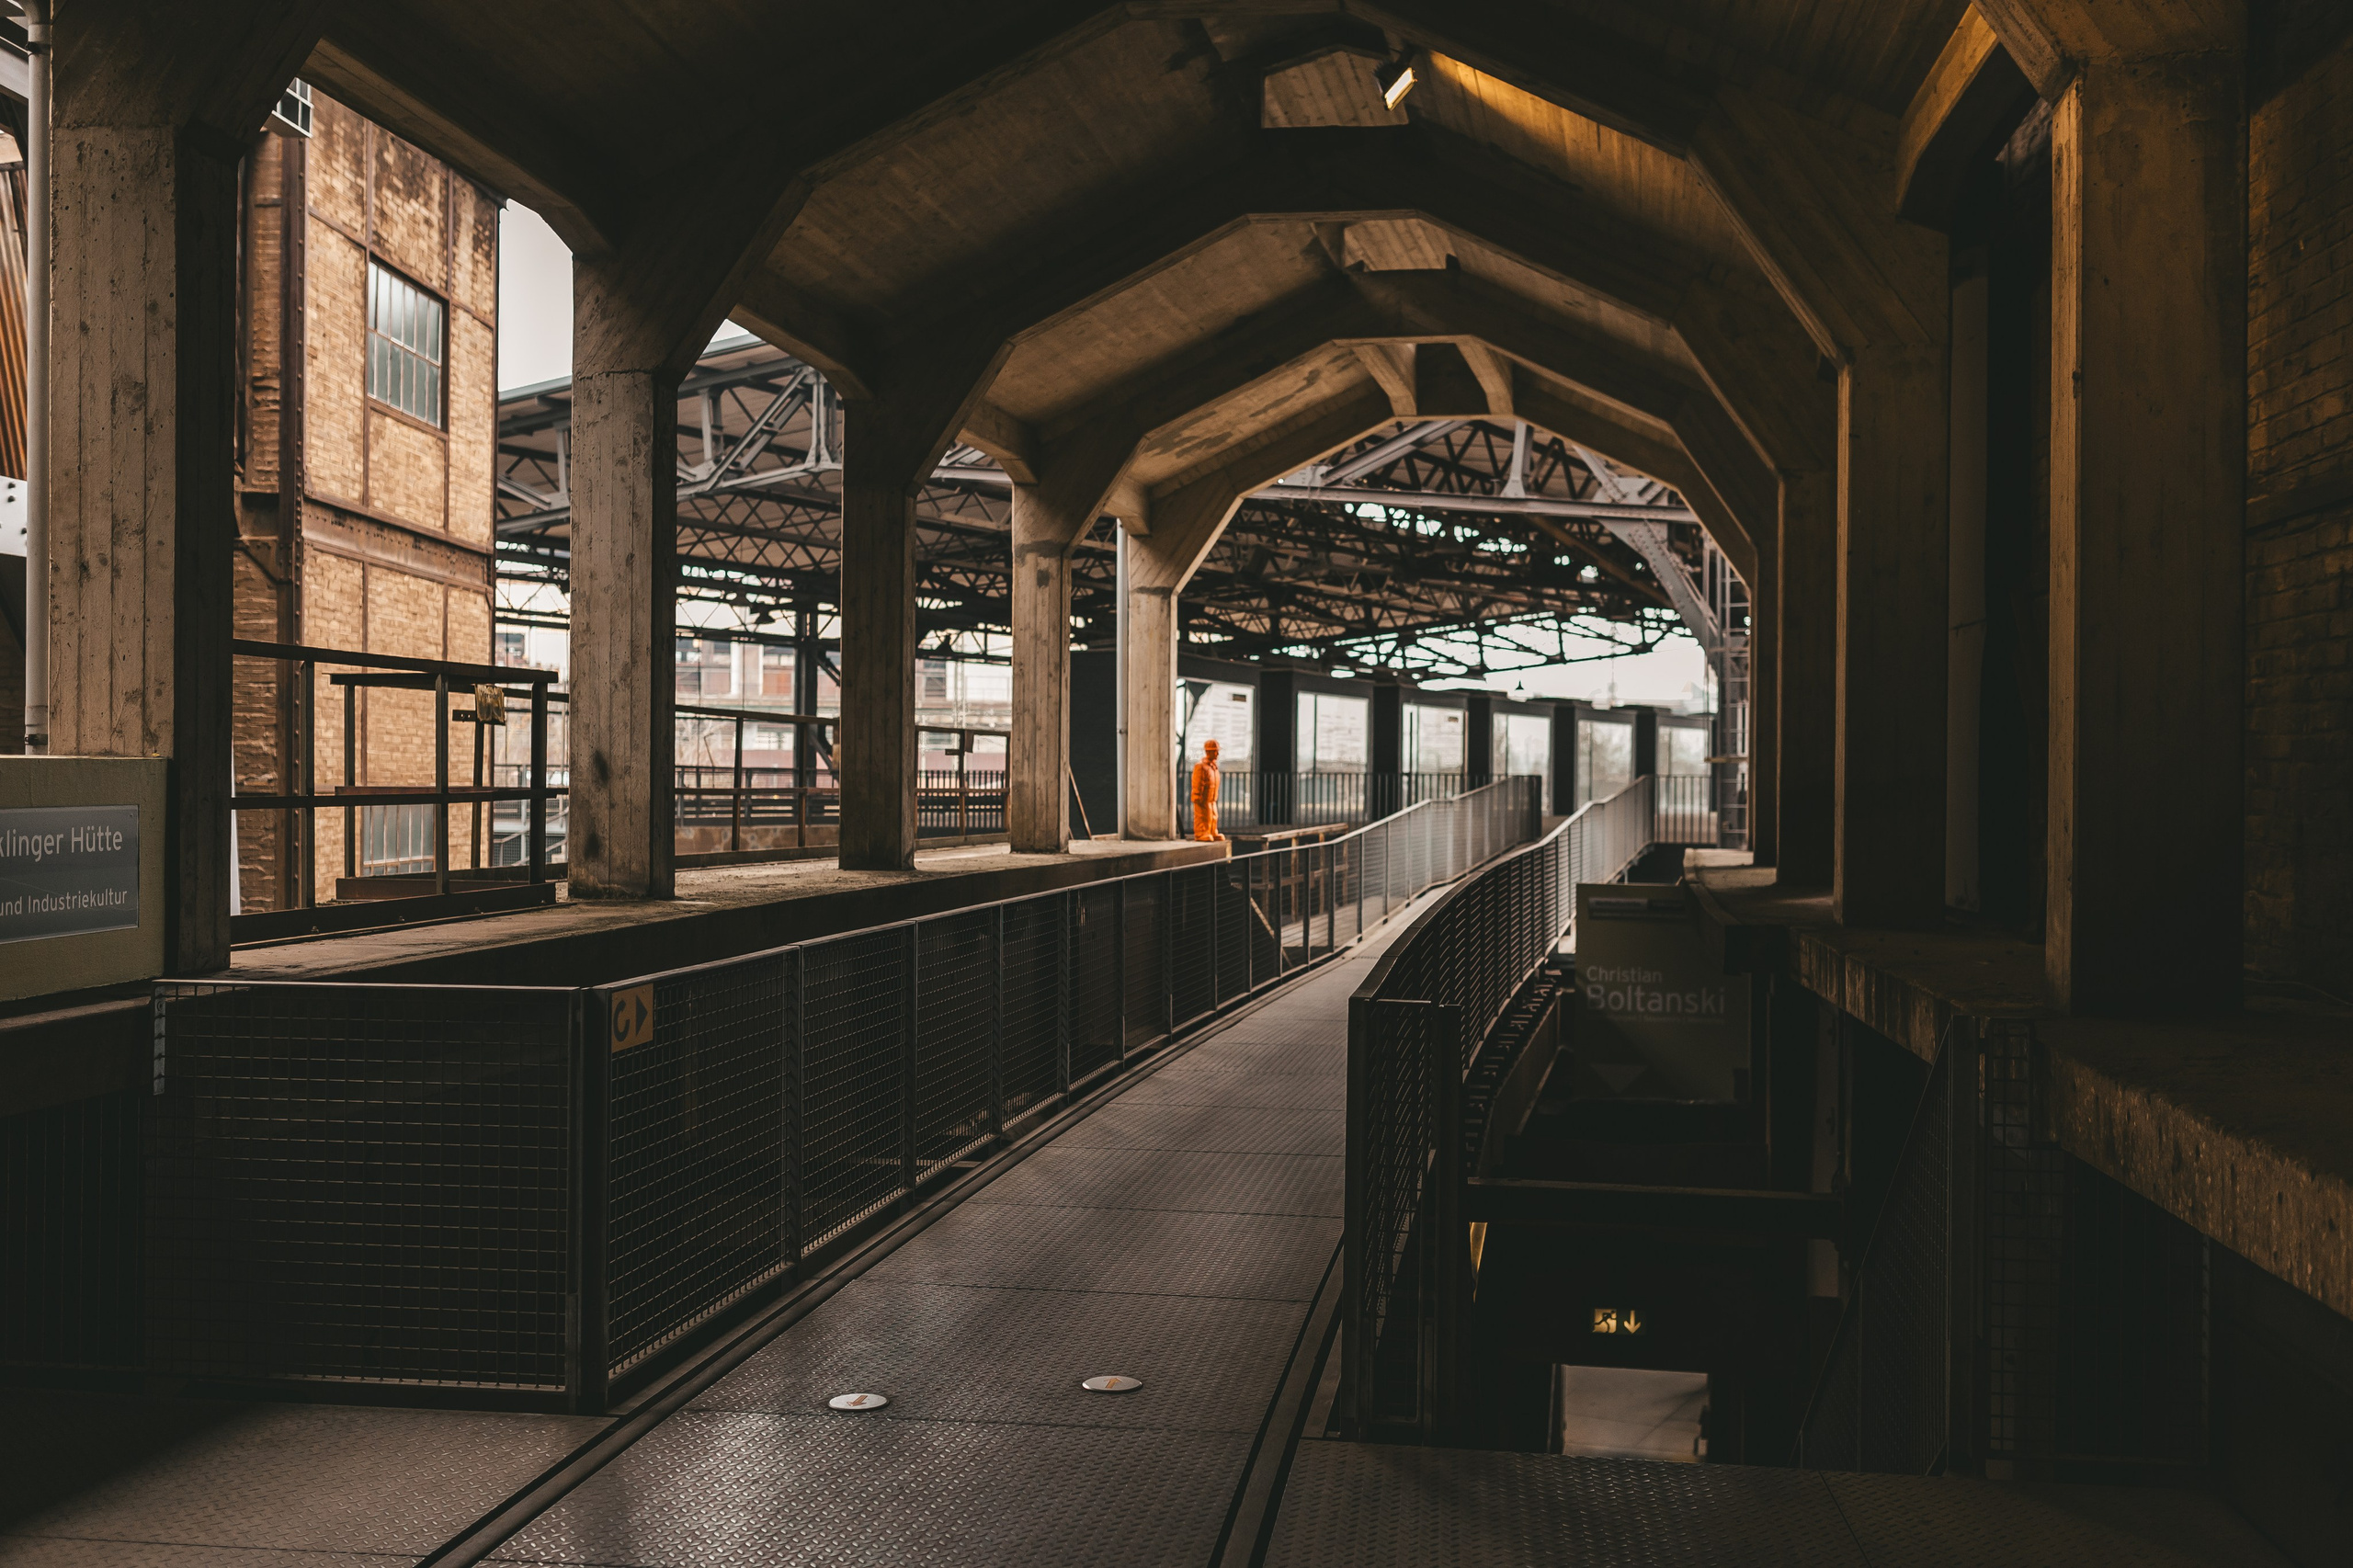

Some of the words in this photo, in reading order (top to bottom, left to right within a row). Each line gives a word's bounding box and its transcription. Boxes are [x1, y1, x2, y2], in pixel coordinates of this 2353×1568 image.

[71, 825, 123, 853] Hütte
[28, 888, 128, 914] Industriekultur
[1586, 966, 1663, 983] Christian
[1586, 984, 1725, 1014] Boltanski
